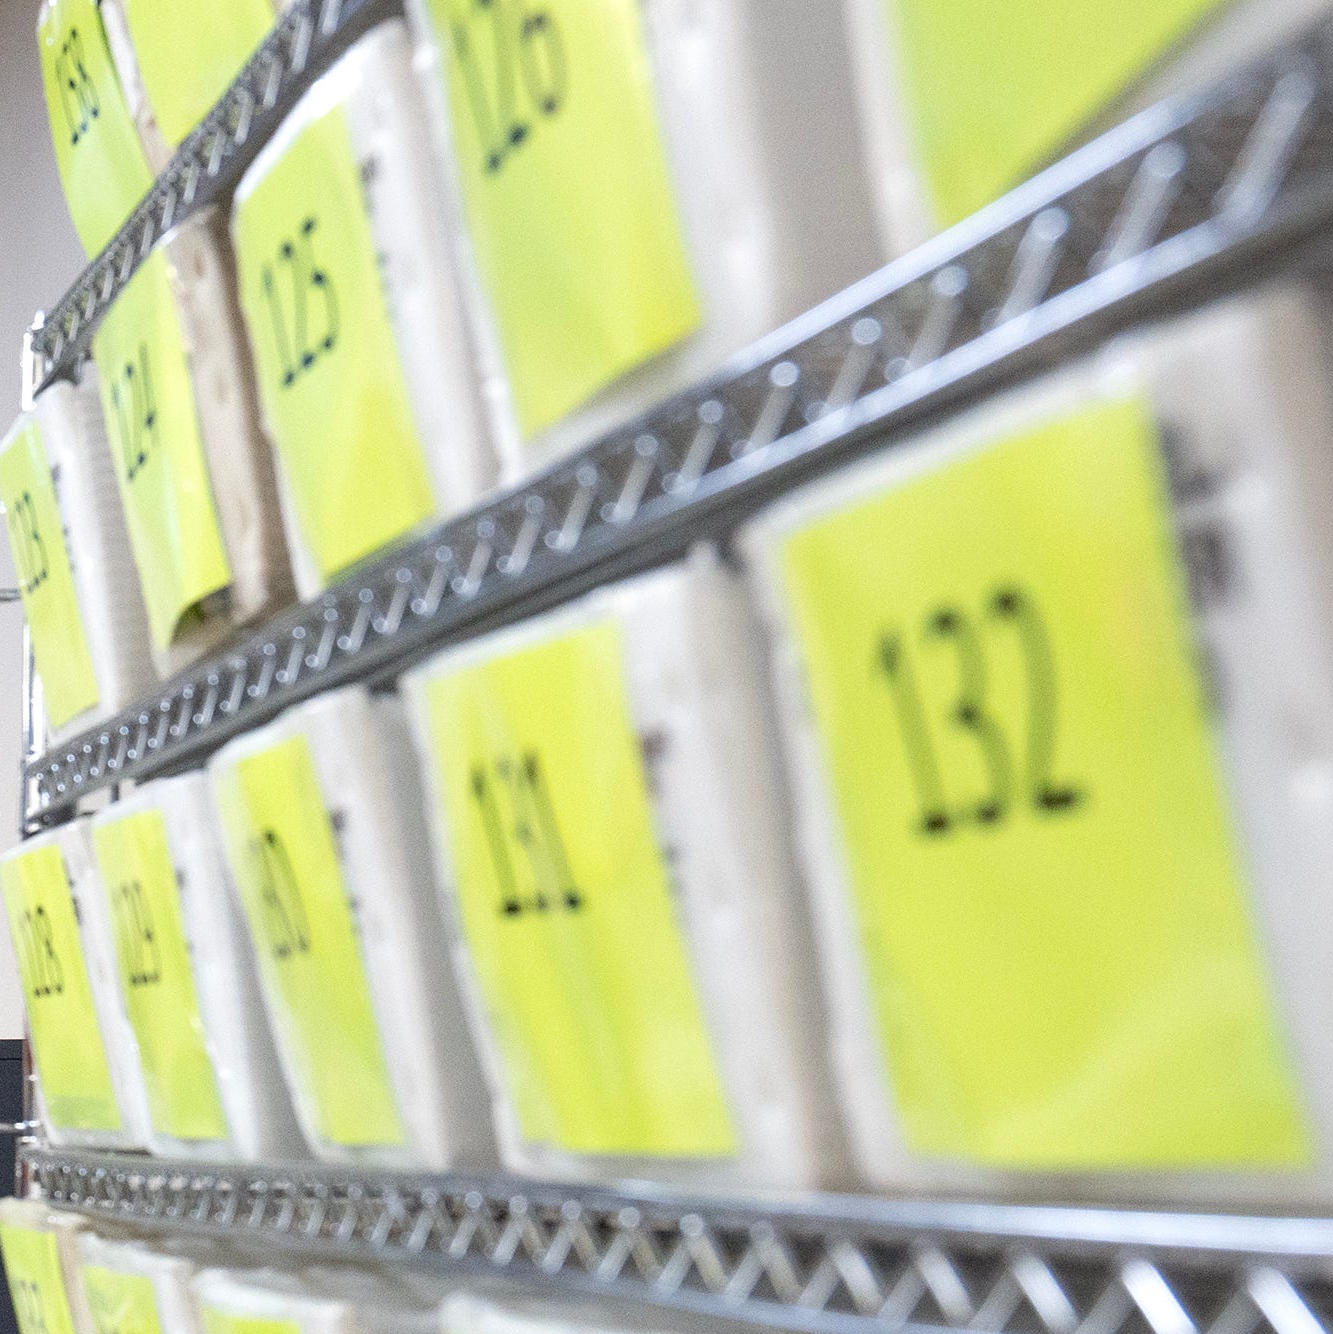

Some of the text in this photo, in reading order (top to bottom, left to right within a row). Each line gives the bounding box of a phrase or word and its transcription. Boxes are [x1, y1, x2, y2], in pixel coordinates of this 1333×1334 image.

[874, 582, 1089, 840] 132
[471, 745, 585, 917] 131
[23, 905, 64, 998] 128
